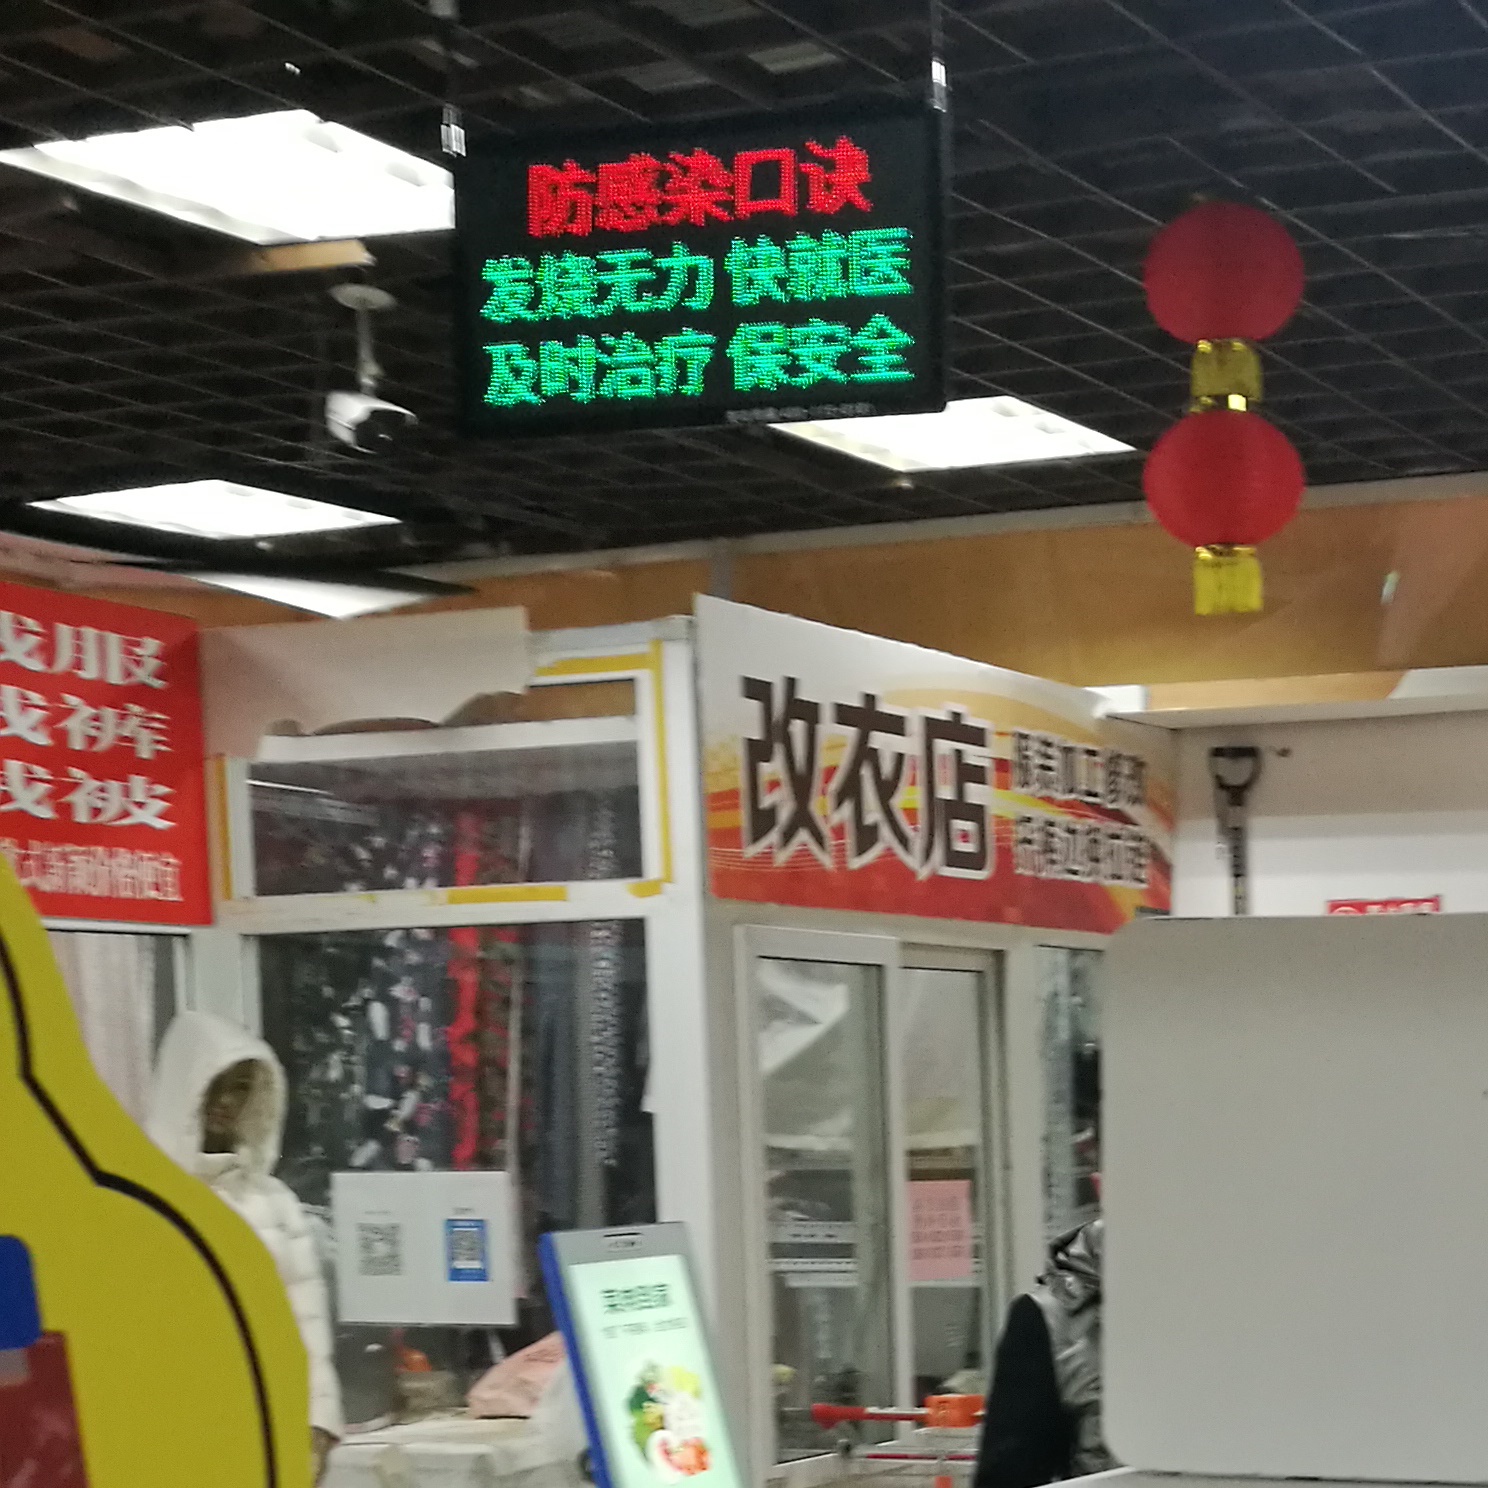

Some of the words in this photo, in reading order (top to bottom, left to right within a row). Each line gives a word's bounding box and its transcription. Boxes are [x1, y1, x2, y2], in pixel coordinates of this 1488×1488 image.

[527, 135, 872, 237] 防感染口诀
[480, 241, 714, 322] 发烧无力
[724, 227, 914, 307] 快就医
[482, 327, 717, 407] 及时治疗
[727, 313, 915, 391] 保安全
[741, 675, 987, 870] 改衣店
